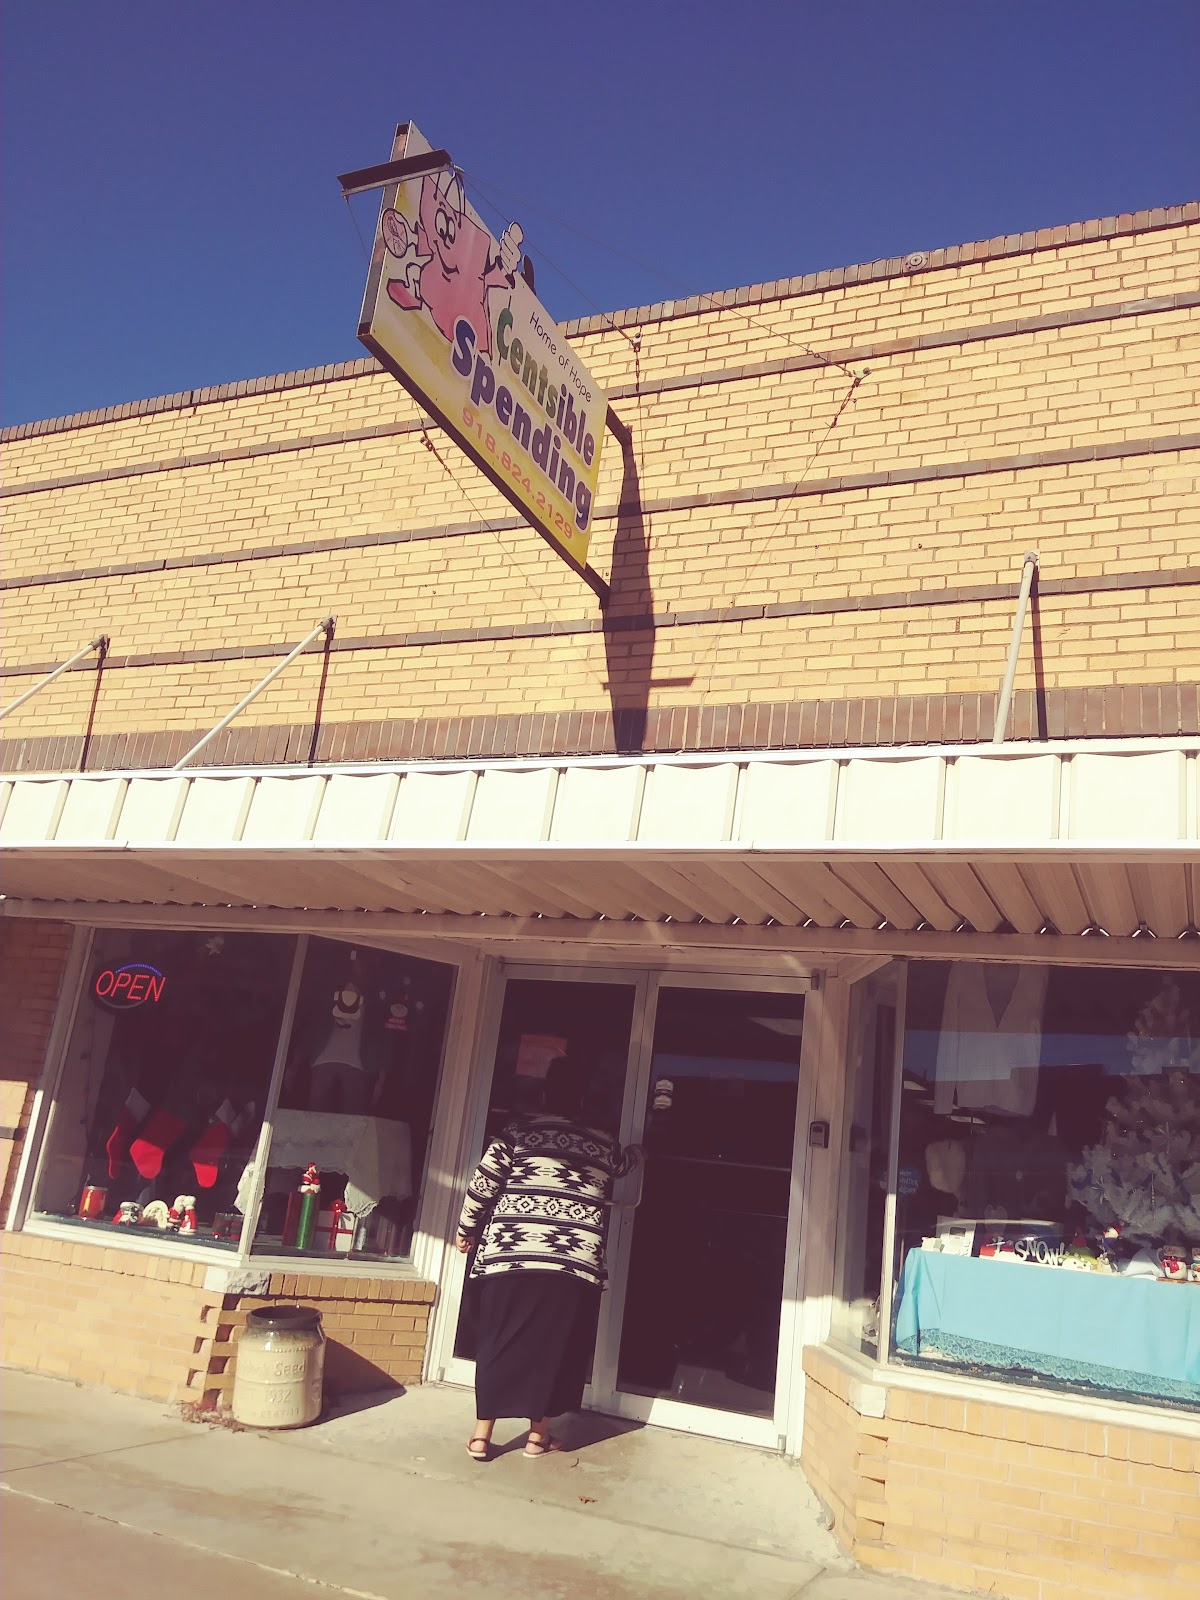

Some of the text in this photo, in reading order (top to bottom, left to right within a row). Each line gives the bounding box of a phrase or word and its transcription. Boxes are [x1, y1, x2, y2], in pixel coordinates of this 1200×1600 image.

[529, 311, 592, 403] Home of Hope
[452, 318, 592, 531] Spending
[462, 406, 573, 540] 918.824.2129
[96, 970, 166, 1002] OPEN
[274, 1358, 306, 1376] Seed
